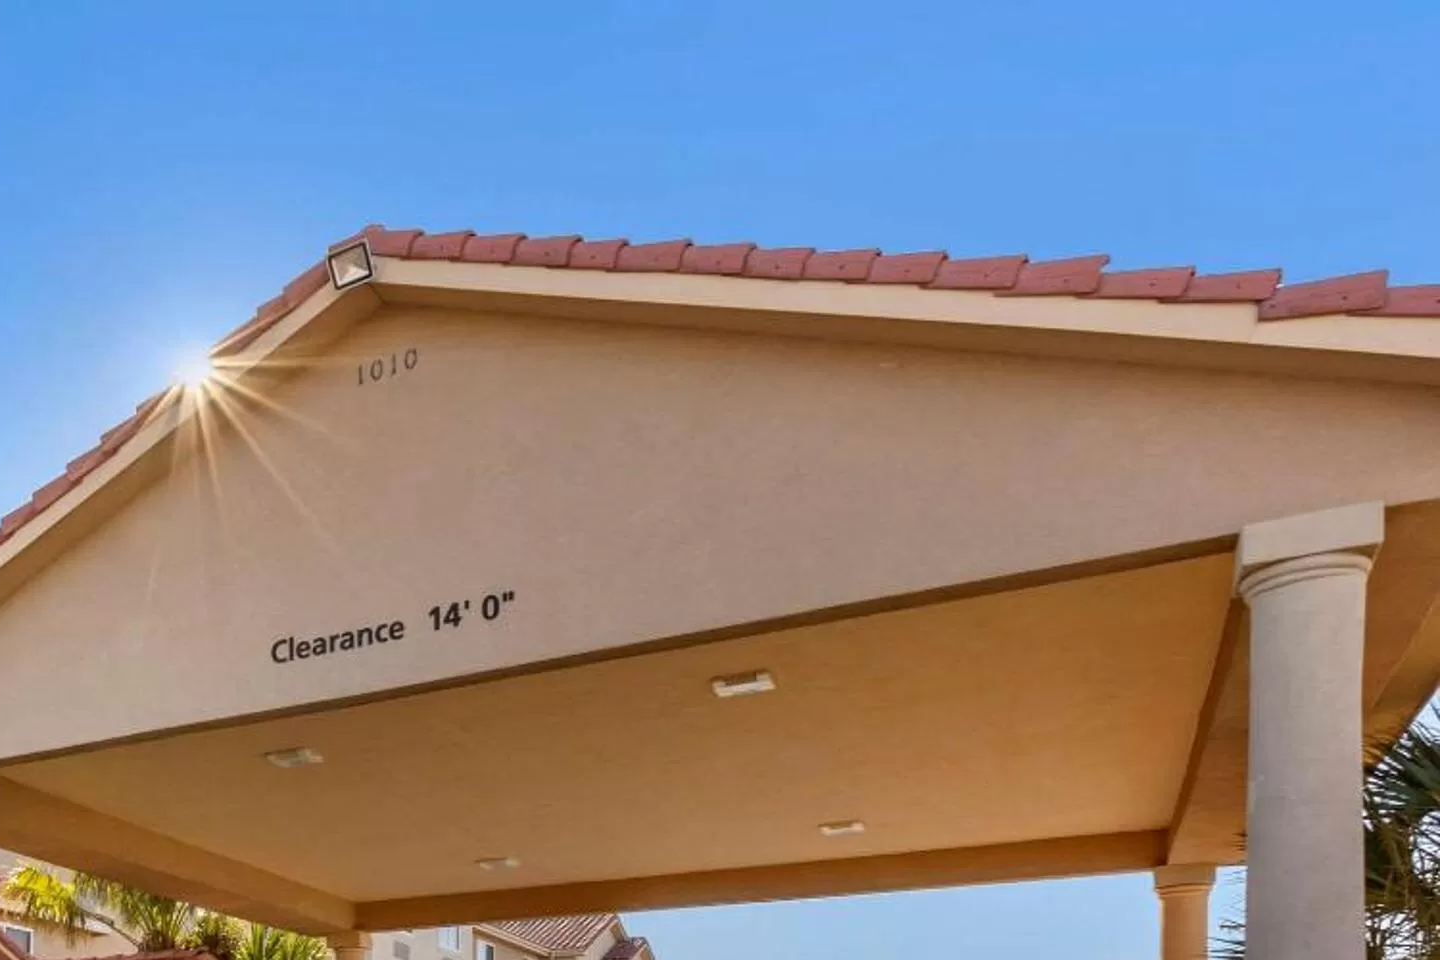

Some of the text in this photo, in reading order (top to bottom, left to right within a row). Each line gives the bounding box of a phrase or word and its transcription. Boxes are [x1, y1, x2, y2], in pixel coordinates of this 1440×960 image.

[358, 348, 418, 386] 1010
[271, 590, 515, 664] Clearance 14' 0"
